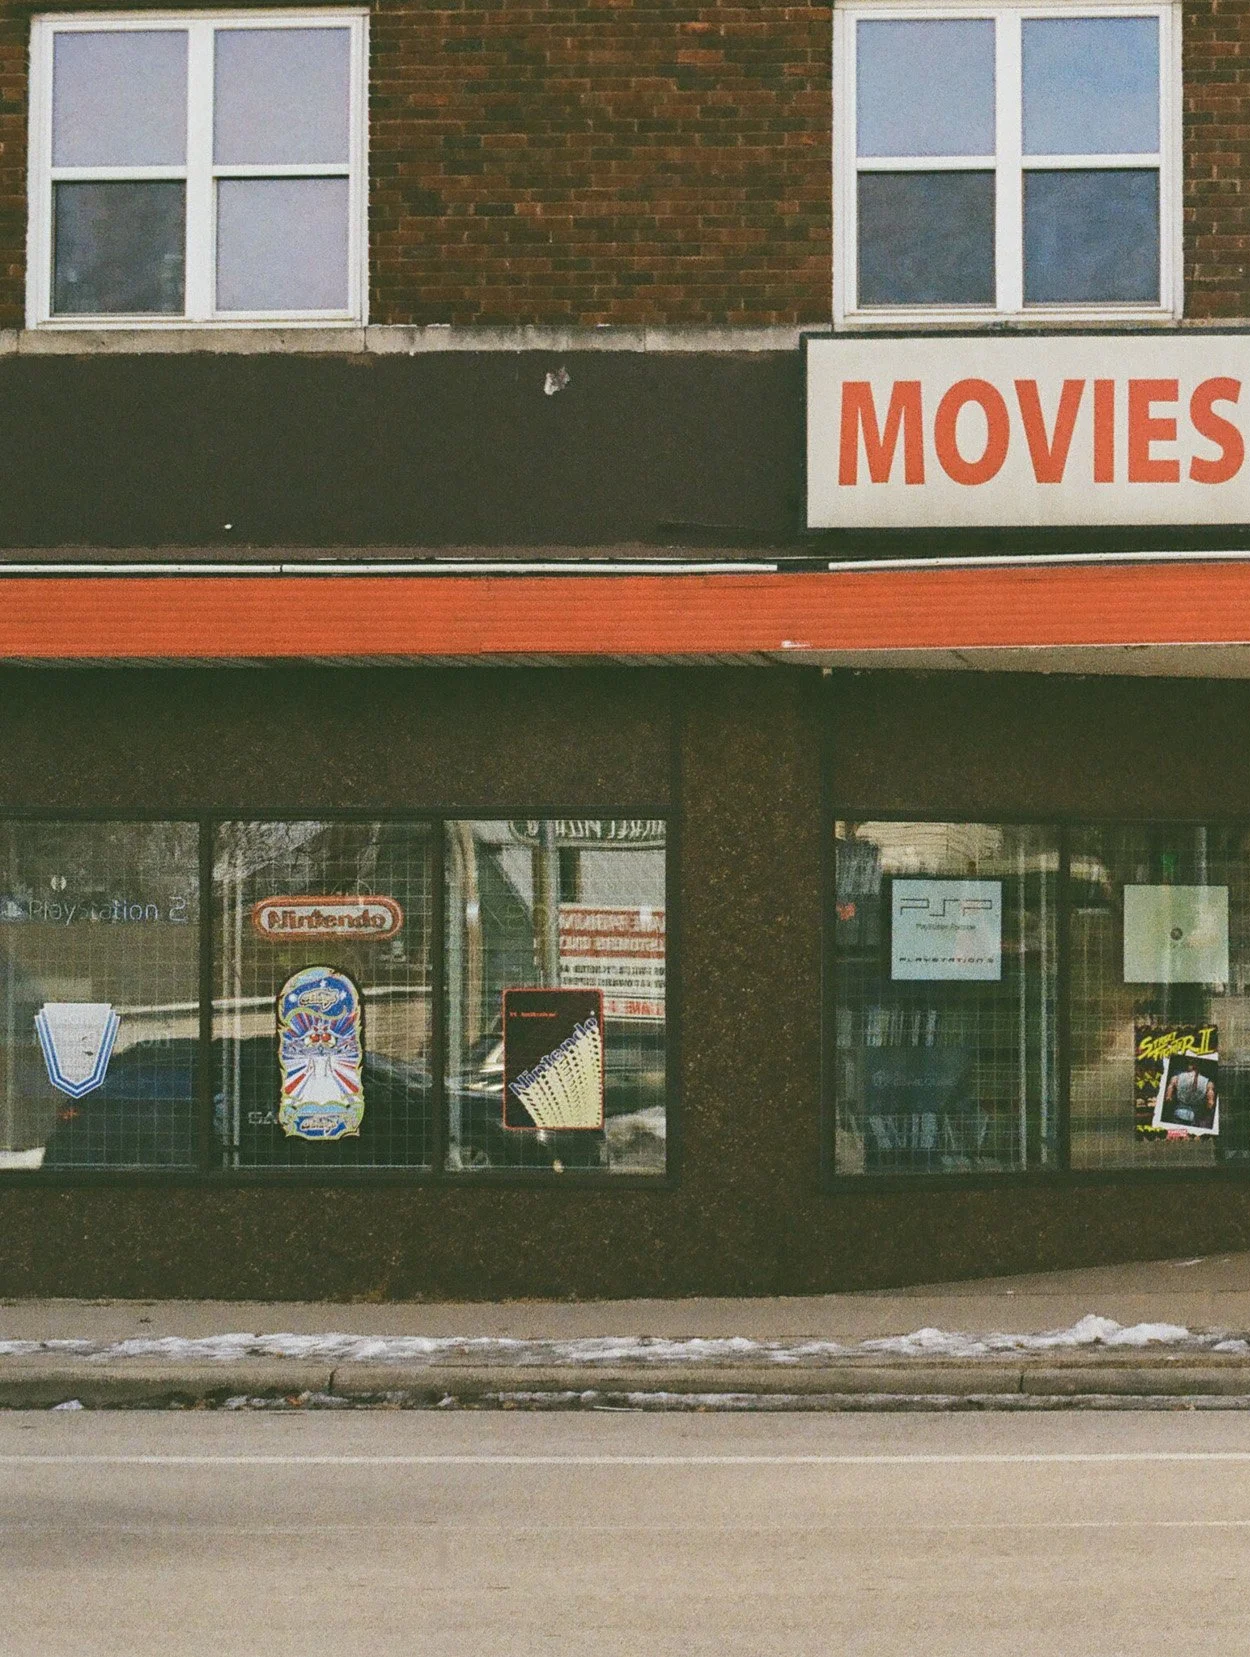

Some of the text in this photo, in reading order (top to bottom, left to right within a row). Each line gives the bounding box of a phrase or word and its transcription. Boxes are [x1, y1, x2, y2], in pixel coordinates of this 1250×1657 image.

[168, 896, 189, 924] 2
[267, 909, 386, 929] Nintendo
[899, 898, 993, 917] PSP
[508, 1017, 598, 1096] Nintendo
